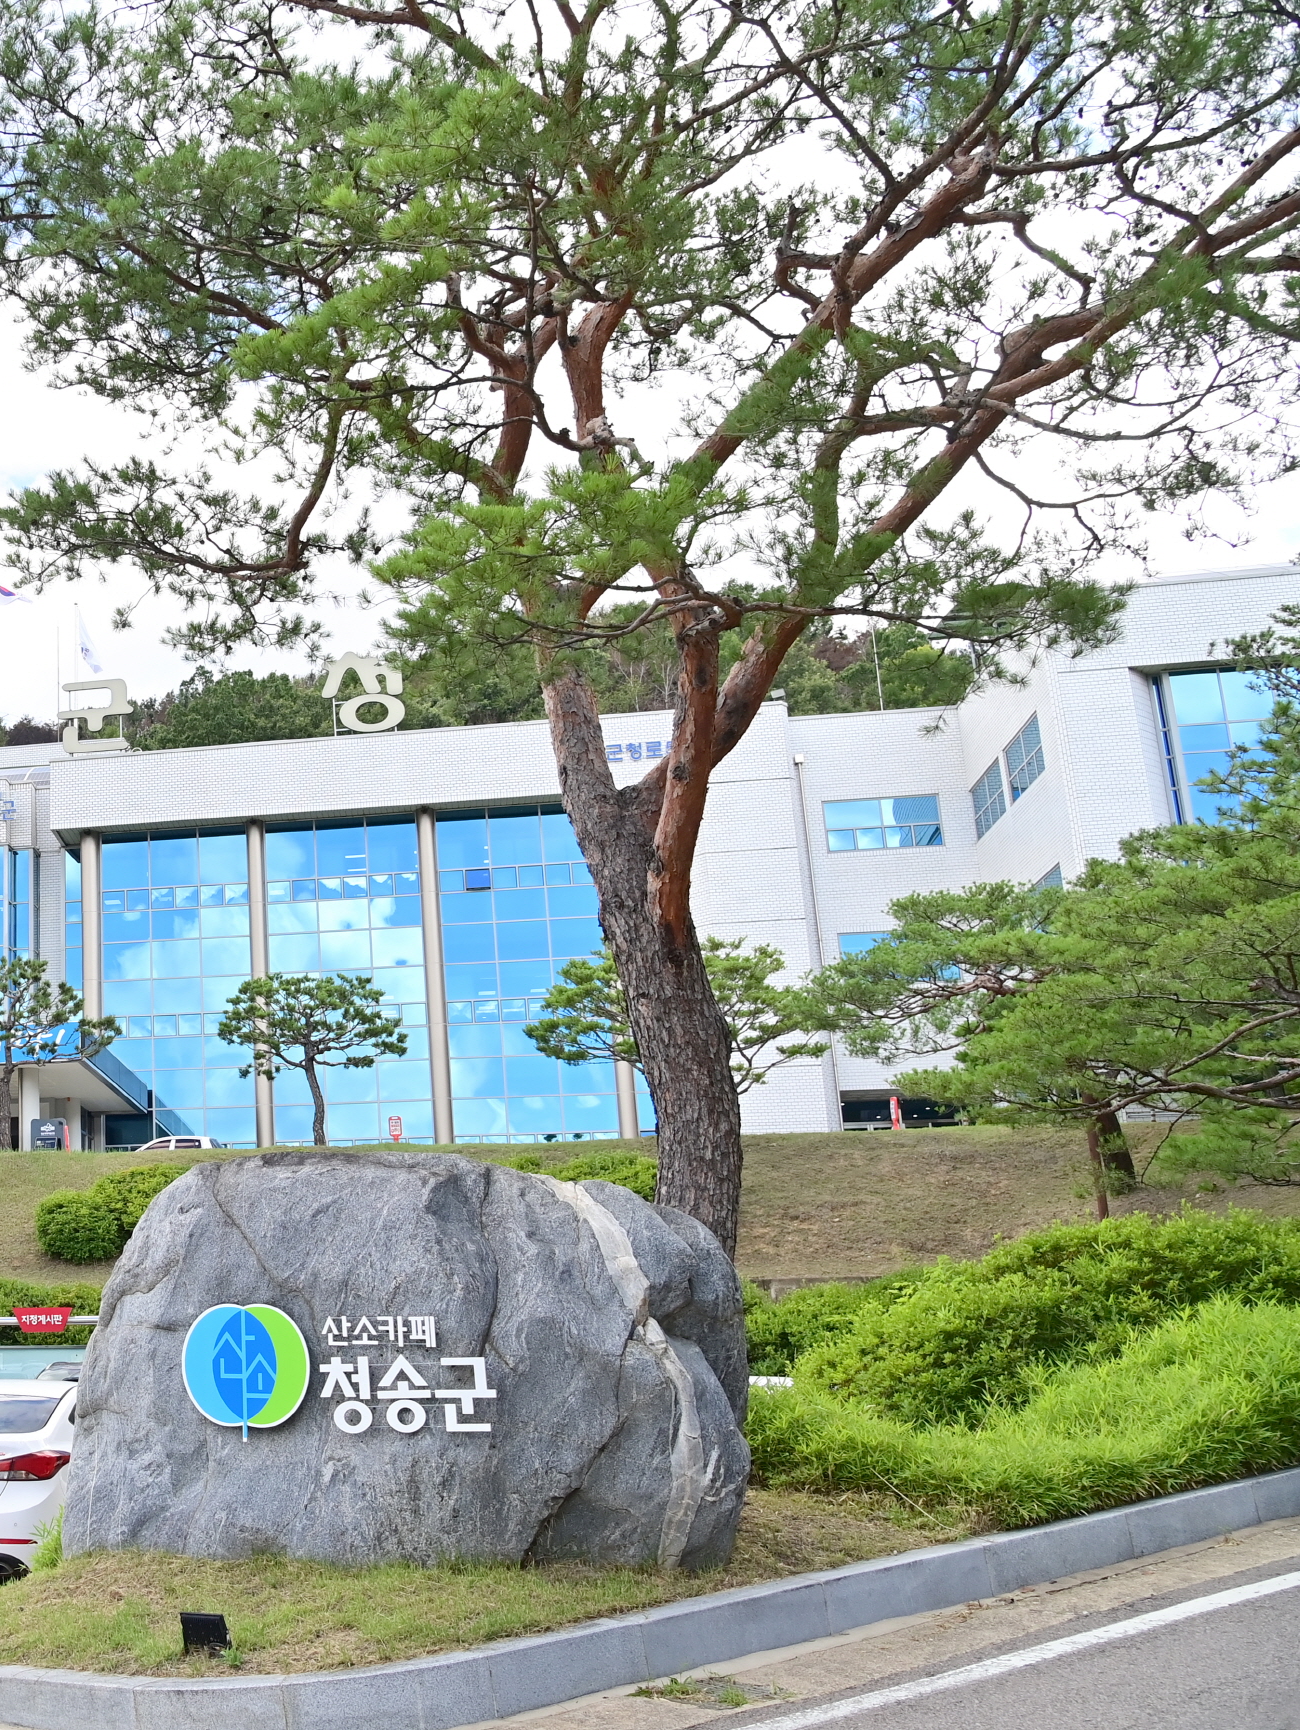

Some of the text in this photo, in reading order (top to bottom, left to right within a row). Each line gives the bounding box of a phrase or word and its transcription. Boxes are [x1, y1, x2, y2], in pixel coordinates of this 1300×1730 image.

[21, 1314, 63, 1326] 지정게시판
[321, 1315, 437, 1348] 산소카페
[319, 1354, 497, 1434] 청송군
